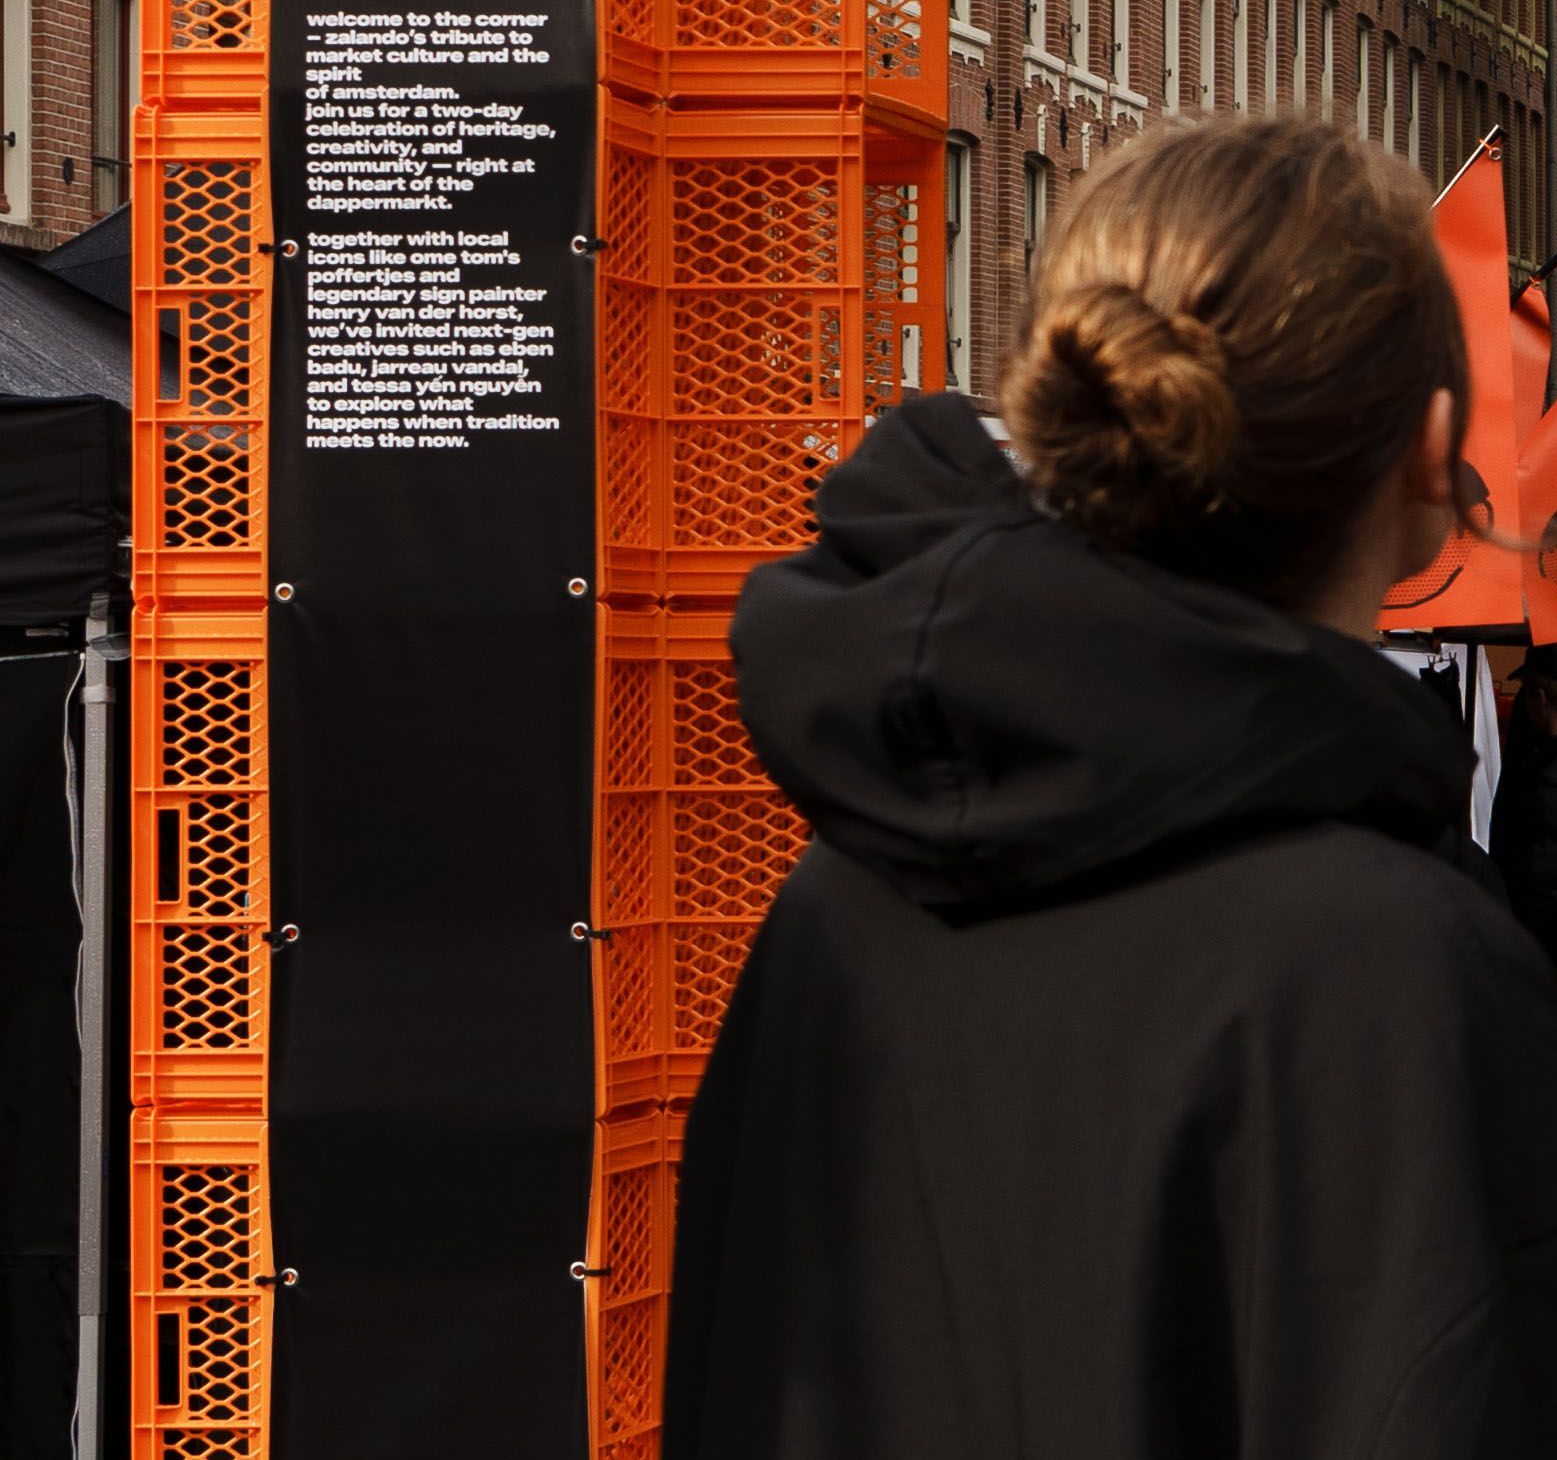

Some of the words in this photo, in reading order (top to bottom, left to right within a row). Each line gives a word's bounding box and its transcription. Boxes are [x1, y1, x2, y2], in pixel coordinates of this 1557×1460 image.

[306, 11, 404, 27] welcome
[406, 11, 432, 27] to
[433, 11, 472, 27] the
[474, 14, 549, 27] corner
[429, 29, 506, 45] tribute
[508, 29, 534, 45] to
[305, 48, 384, 63] market
[385, 48, 465, 63] culture
[467, 47, 509, 63] and
[511, 47, 550, 63] the
[305, 66, 363, 85] spirit
[305, 84, 330, 100] of
[332, 84, 460, 100] amsterdam.
[305, 103, 345, 121] join
[347, 106, 375, 118] us
[377, 102, 411, 118] for
[413, 105, 428, 118] a
[430, 102, 524, 121] two-day
[305, 121, 429, 136] celebration
[431, 121, 456, 136] of
[458, 121, 556, 139] heritage,
[306, 139, 418, 158] creativity,
[421, 139, 463, 155] and
[306, 158, 428, 176] community
[456, 157, 509, 176] right
[511, 157, 536, 173] at
[306, 176, 345, 192] the
[347, 176, 407, 191] heart
[409, 176, 434, 191] of
[436, 176, 474, 191] the
[306, 194, 453, 213] dappermarkt.
[307, 231, 404, 250] together
[406, 231, 455, 246] with
[457, 231, 509, 246] local
[307, 249, 366, 265] icons
[368, 250, 407, 265] like
[409, 252, 458, 265] ome
[307, 268, 416, 286] poffertjes
[418, 267, 461, 283] and
[307, 286, 417, 305] legendary
[419, 286, 466, 305] sign
[468, 286, 548, 305] painter
[307, 304, 372, 323] henry
[374, 307, 416, 320] van
[418, 304, 456, 320] der
[458, 304, 524, 323] horst,
